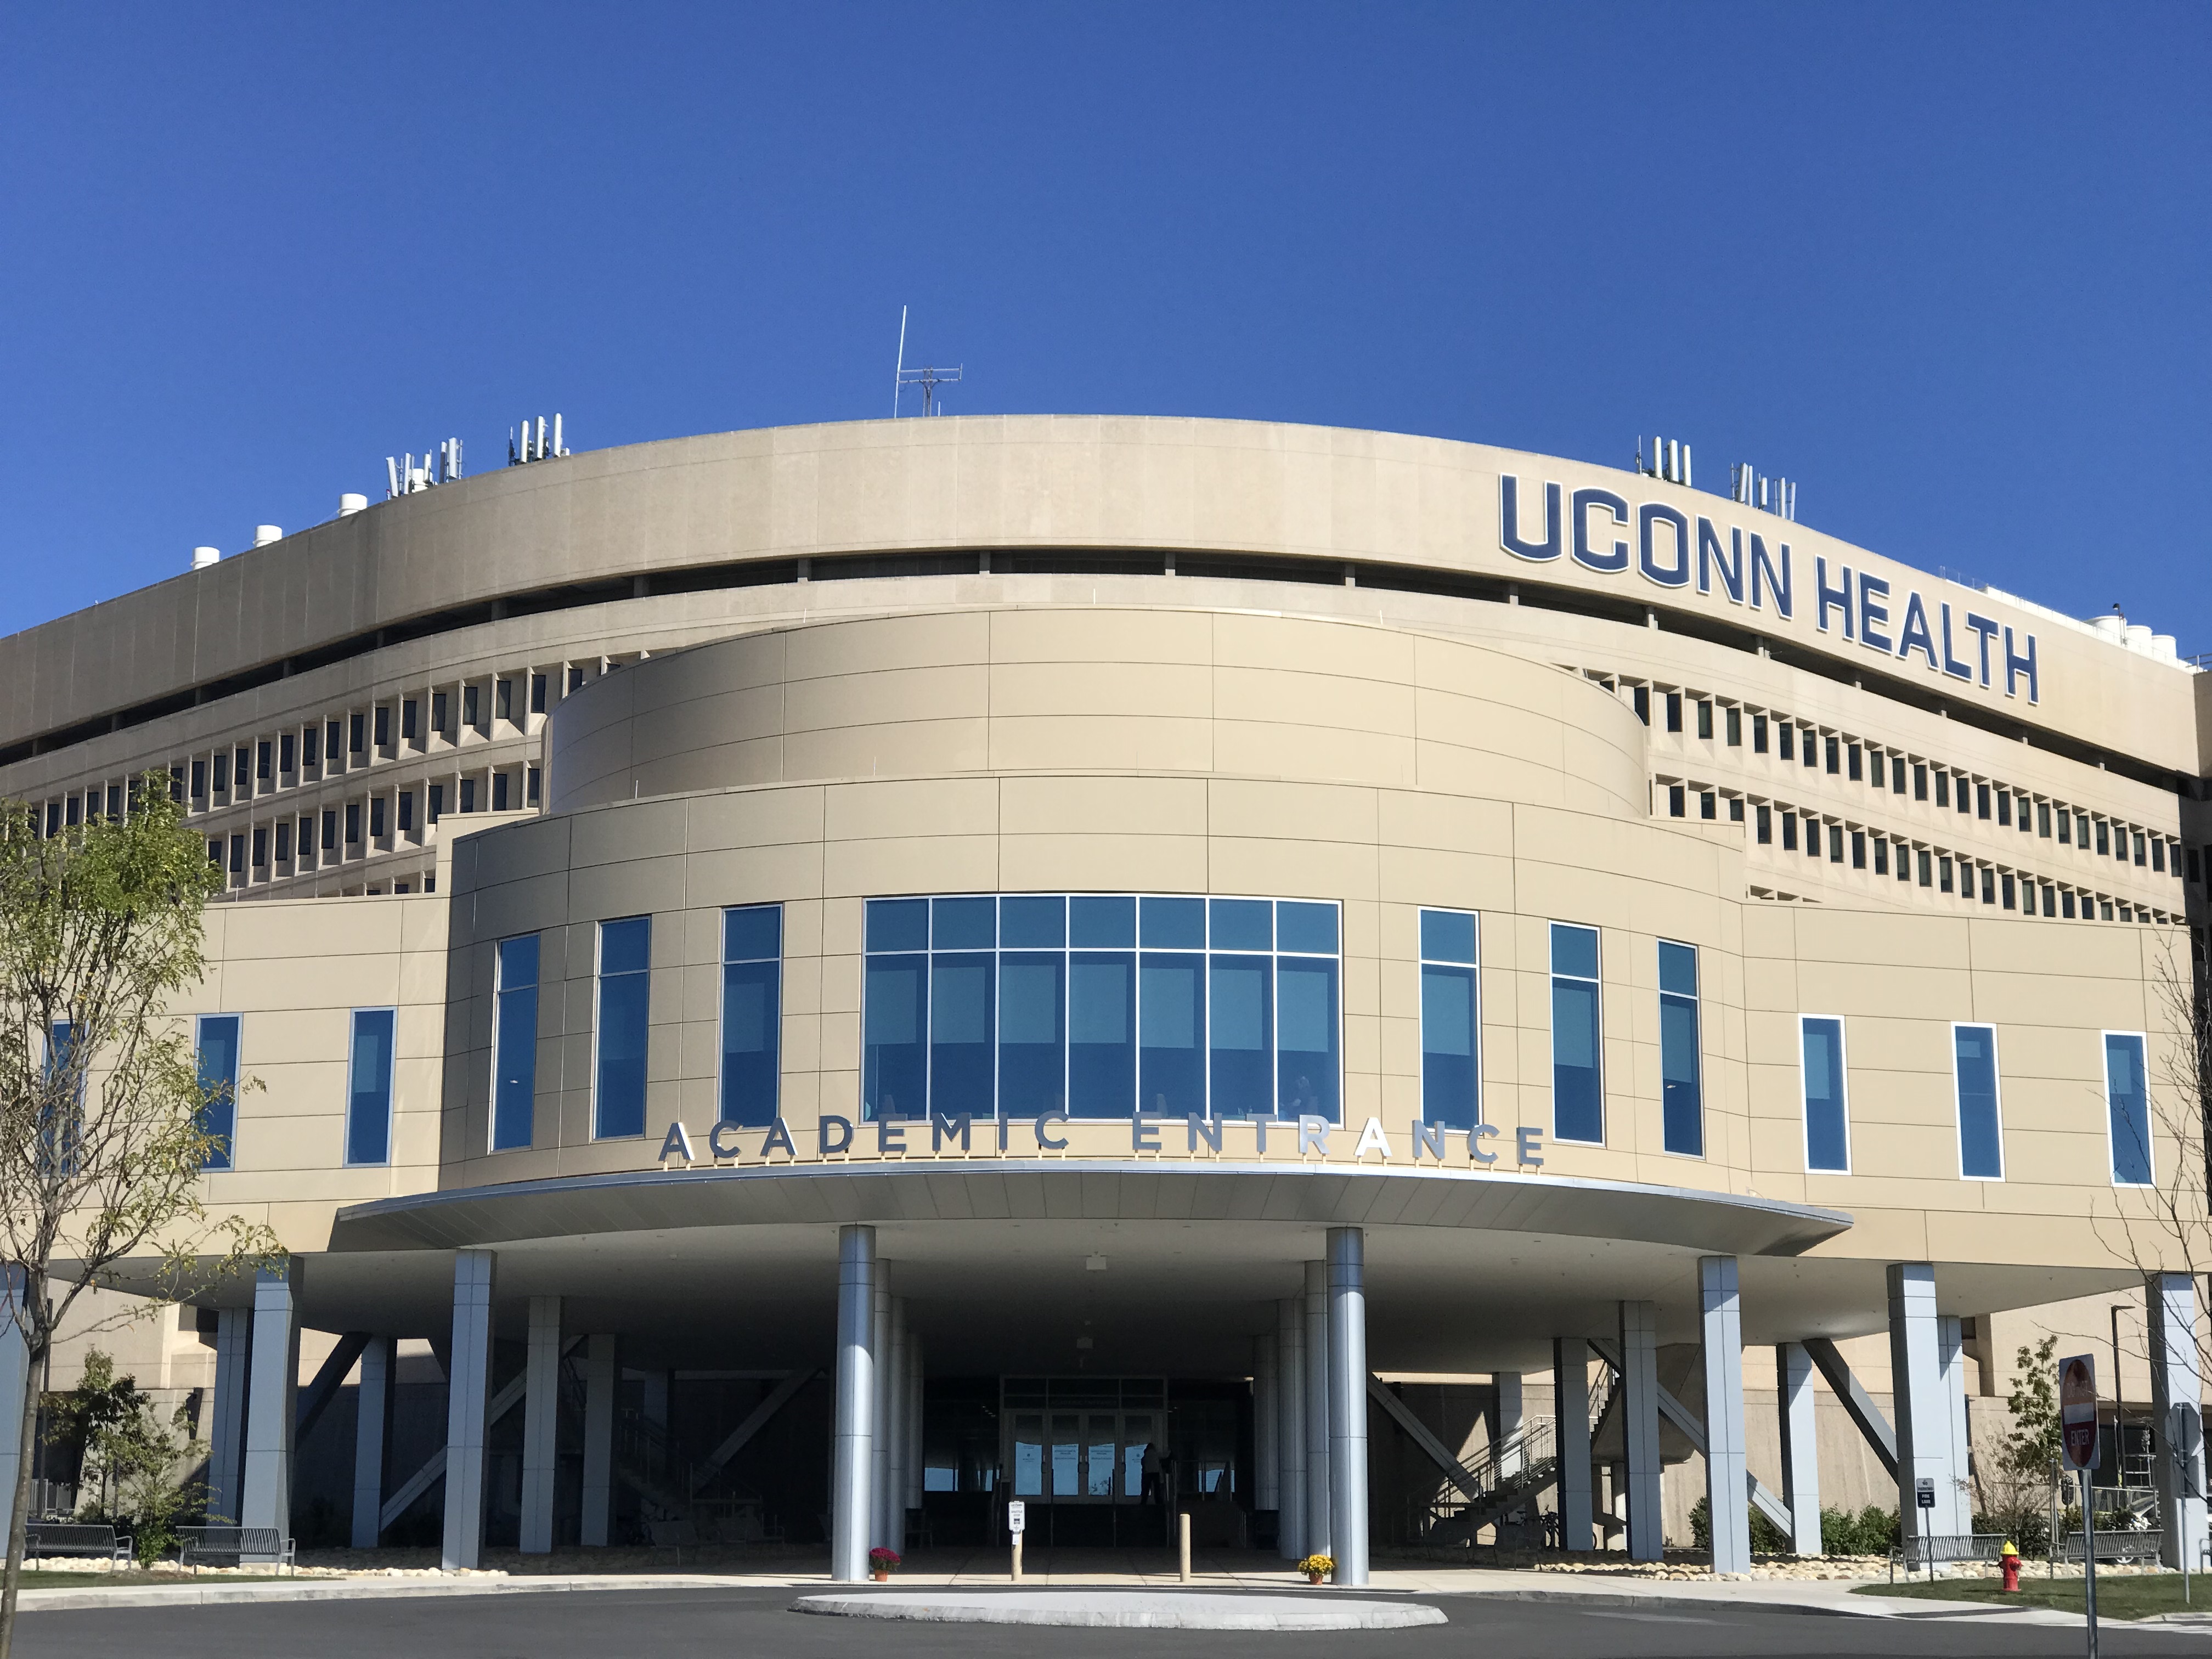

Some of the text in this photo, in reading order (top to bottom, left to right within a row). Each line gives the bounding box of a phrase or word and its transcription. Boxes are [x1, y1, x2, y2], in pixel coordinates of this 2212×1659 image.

[1499, 473, 2040, 706] UCONN HEALTH
[658, 1109, 1545, 1167] ACADEMIC ENTRANCE
[2071, 1429, 2089, 1446] ENTER
